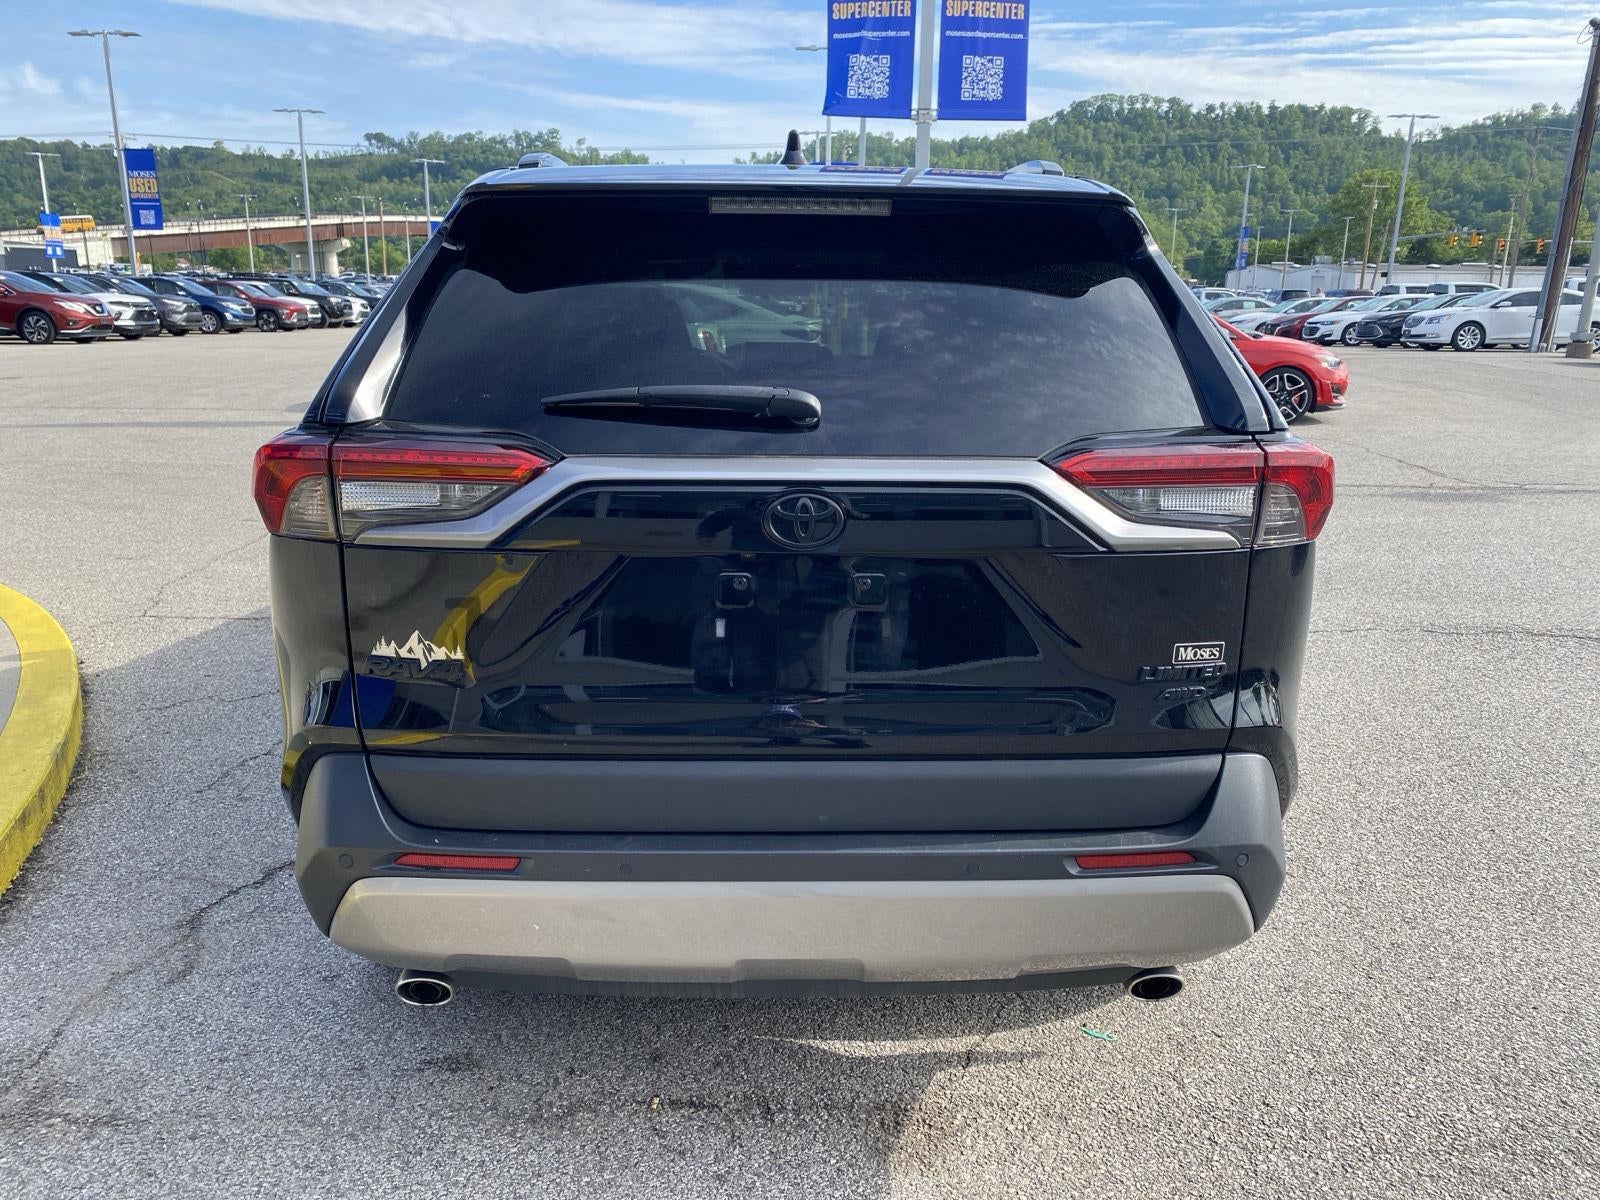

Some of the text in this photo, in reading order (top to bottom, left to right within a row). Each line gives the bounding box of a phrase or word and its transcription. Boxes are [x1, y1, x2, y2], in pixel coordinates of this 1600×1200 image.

[832, 0, 911, 20] SUPERCENTER
[946, 0, 1025, 20] SUPERCENTER
[833, 29, 911, 39] mosesusedsupercenter.com
[945, 29, 1024, 39] mosesusedsupercenter.com
[128, 170, 156, 178] MOSES
[129, 177, 158, 193] USED
[1137, 662, 1226, 681] LIMITED
